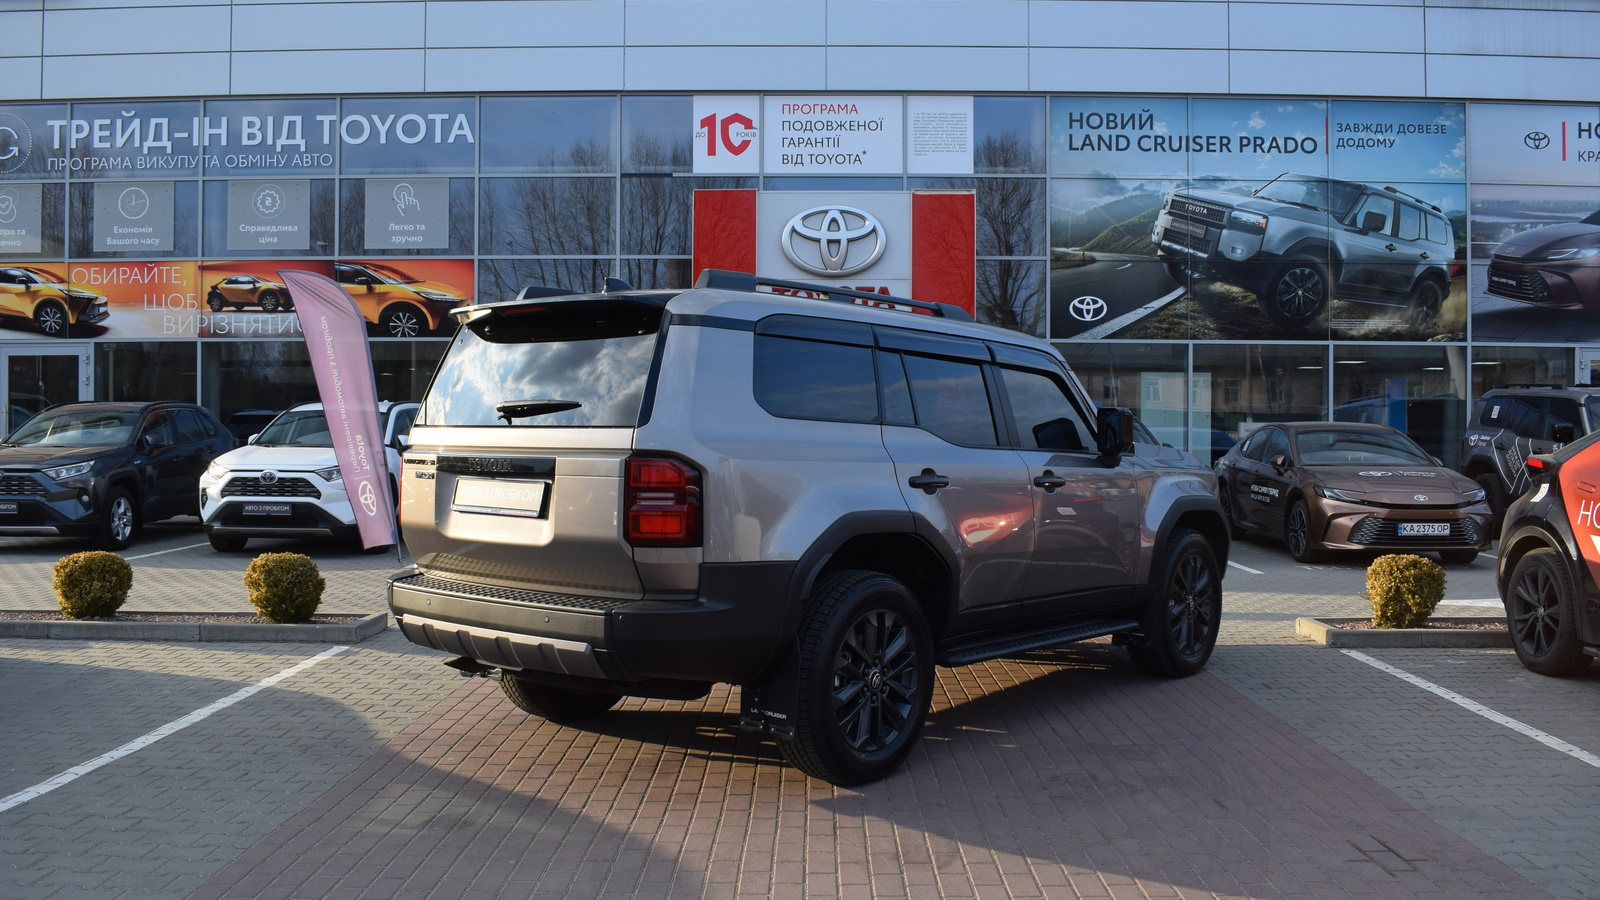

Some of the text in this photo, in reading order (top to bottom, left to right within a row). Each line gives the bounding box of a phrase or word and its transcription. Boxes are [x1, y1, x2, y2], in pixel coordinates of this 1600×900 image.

[781, 103, 859, 115] ПРОГРАМА
[781, 118, 884, 133] ПОДОВЖЕНОЇ
[1068, 109, 1154, 130] НОВИЙ
[47, 110, 475, 154] ТРЕЙД-ІН ВІД TOYOTA
[1336, 122, 1448, 135] ЗАВЖДИ ДОВЕЗЕ
[781, 134, 841, 148] ГАРАНТІЇ
[1068, 133, 1318, 154] LAND CRUISER PRADO
[1336, 138, 1396, 149] ДОДОМУ
[47, 153, 333, 171] ПРОГРАМА ВИКУПУ ТА ОБМІНУ АВТО
[781, 153, 804, 166] ВІД
[1185, 204, 1208, 214] TOYOTA
[113, 225, 153, 234] Економія
[239, 223, 298, 233] Справедлива
[388, 223, 415, 231] Легко
[107, 237, 160, 246] Вашого часу
[259, 235, 278, 244] ціна
[391, 234, 423, 243] зручно
[71, 263, 188, 287] ОБИРАЙТЕ,
[144, 293, 198, 313] ЩОБ
[468, 457, 514, 472] TOYOTA
[460, 486, 483, 497] АВТО
[492, 488, 539, 501] ПРОБІГОМ
[1402, 525, 1450, 534] KA 2375 OP
